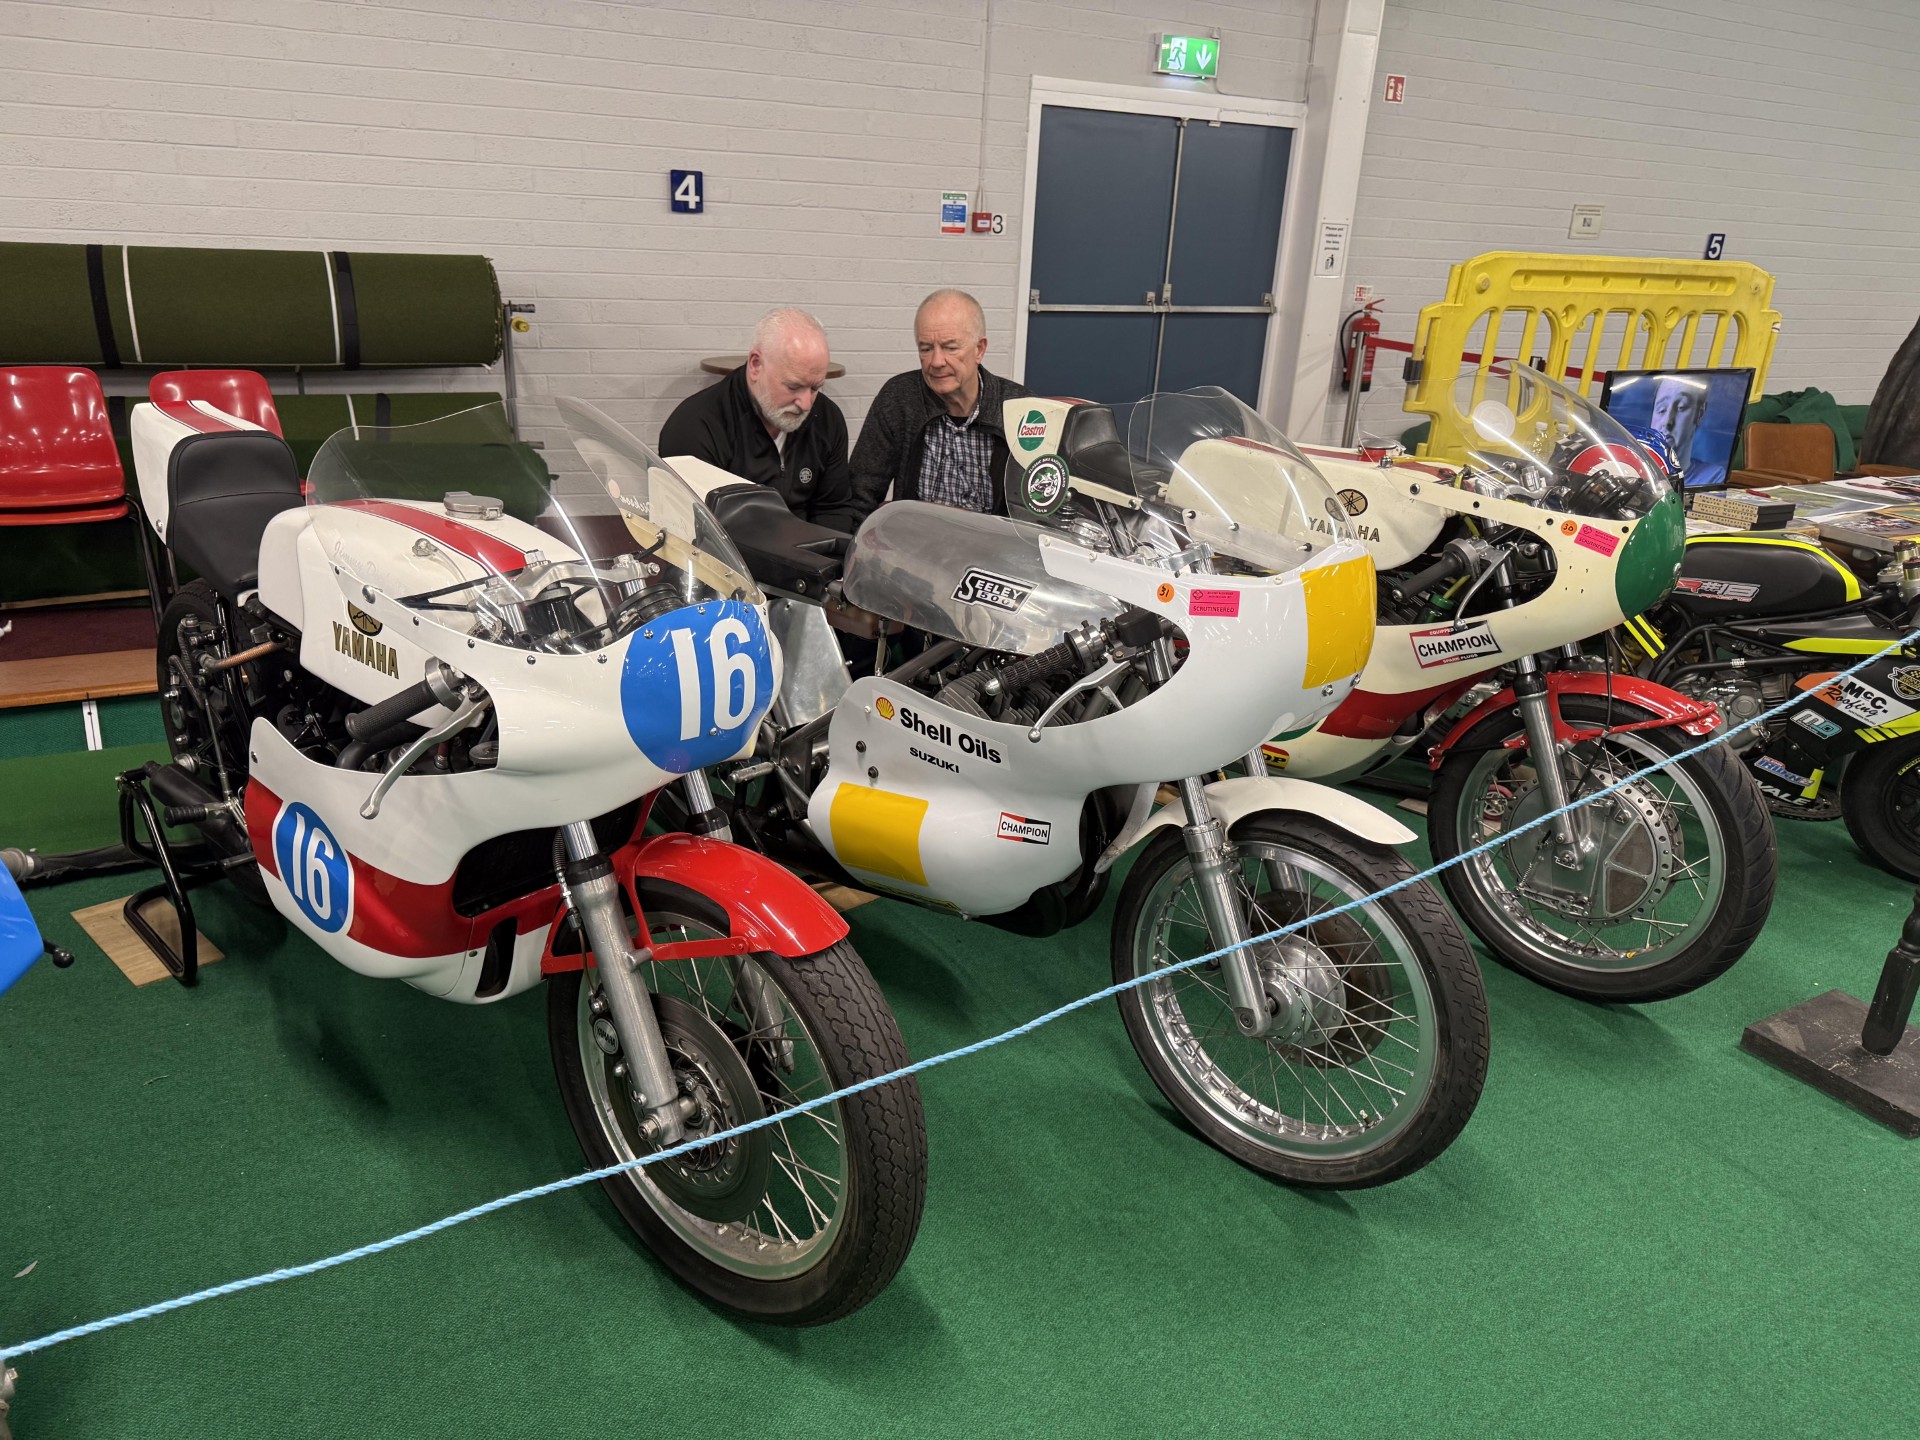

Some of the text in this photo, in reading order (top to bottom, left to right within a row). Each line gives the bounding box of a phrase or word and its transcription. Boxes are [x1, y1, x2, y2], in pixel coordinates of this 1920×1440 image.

[674, 174, 700, 209] 4
[992, 214, 1003, 234] 3
[1708, 236, 1723, 258] 5
[1021, 425, 1046, 436] Castrol
[958, 573, 1023, 600] SEELEY
[981, 592, 1010, 605] 500
[1160, 585, 1169, 597] 31
[333, 620, 399, 680] YAMAHA
[1418, 634, 1492, 657] CHAMPION
[671, 617, 756, 741] 16
[1823, 686, 1879, 717] Roofing
[900, 708, 1001, 763] Shell Oils
[910, 747, 959, 773] SUZUKI
[1001, 822, 1048, 838] CHAMPION
[293, 812, 334, 920] 16
